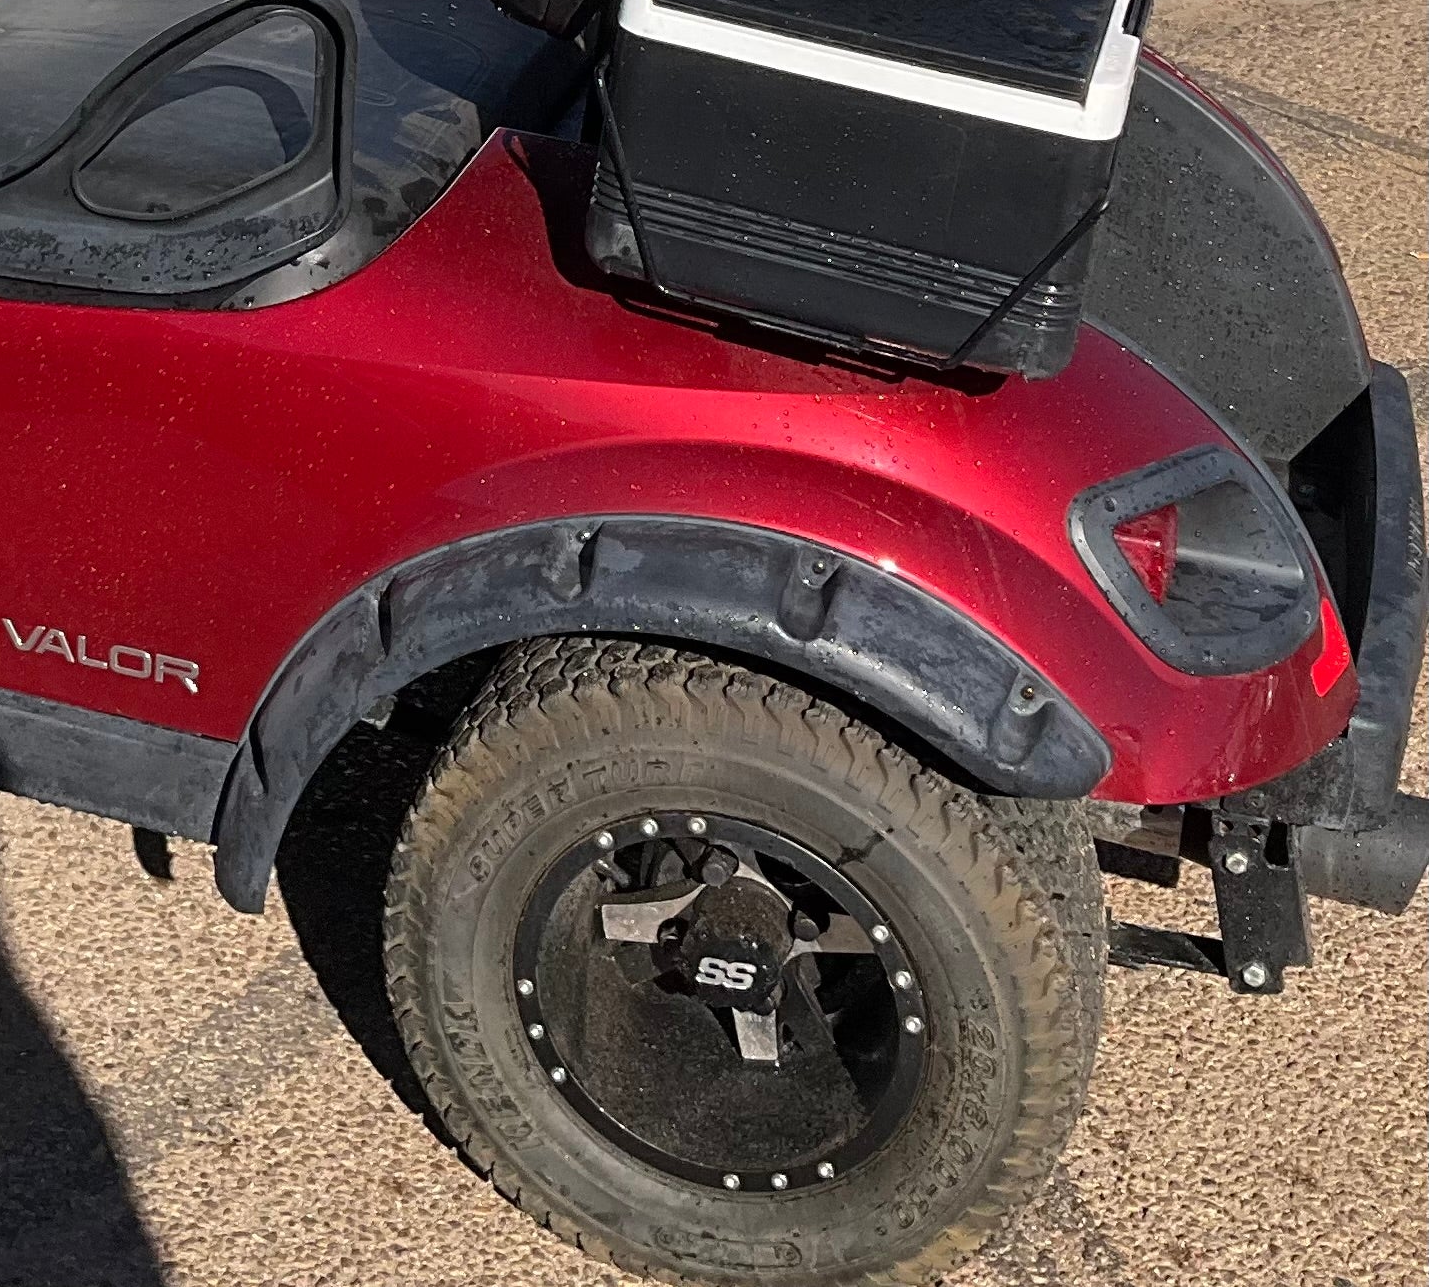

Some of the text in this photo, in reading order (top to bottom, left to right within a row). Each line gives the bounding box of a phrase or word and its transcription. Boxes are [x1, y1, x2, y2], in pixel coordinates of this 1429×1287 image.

[1, 617, 200, 694] VALOR
[468, 759, 711, 883] SUPER TURF
[695, 957, 757, 990] SS
